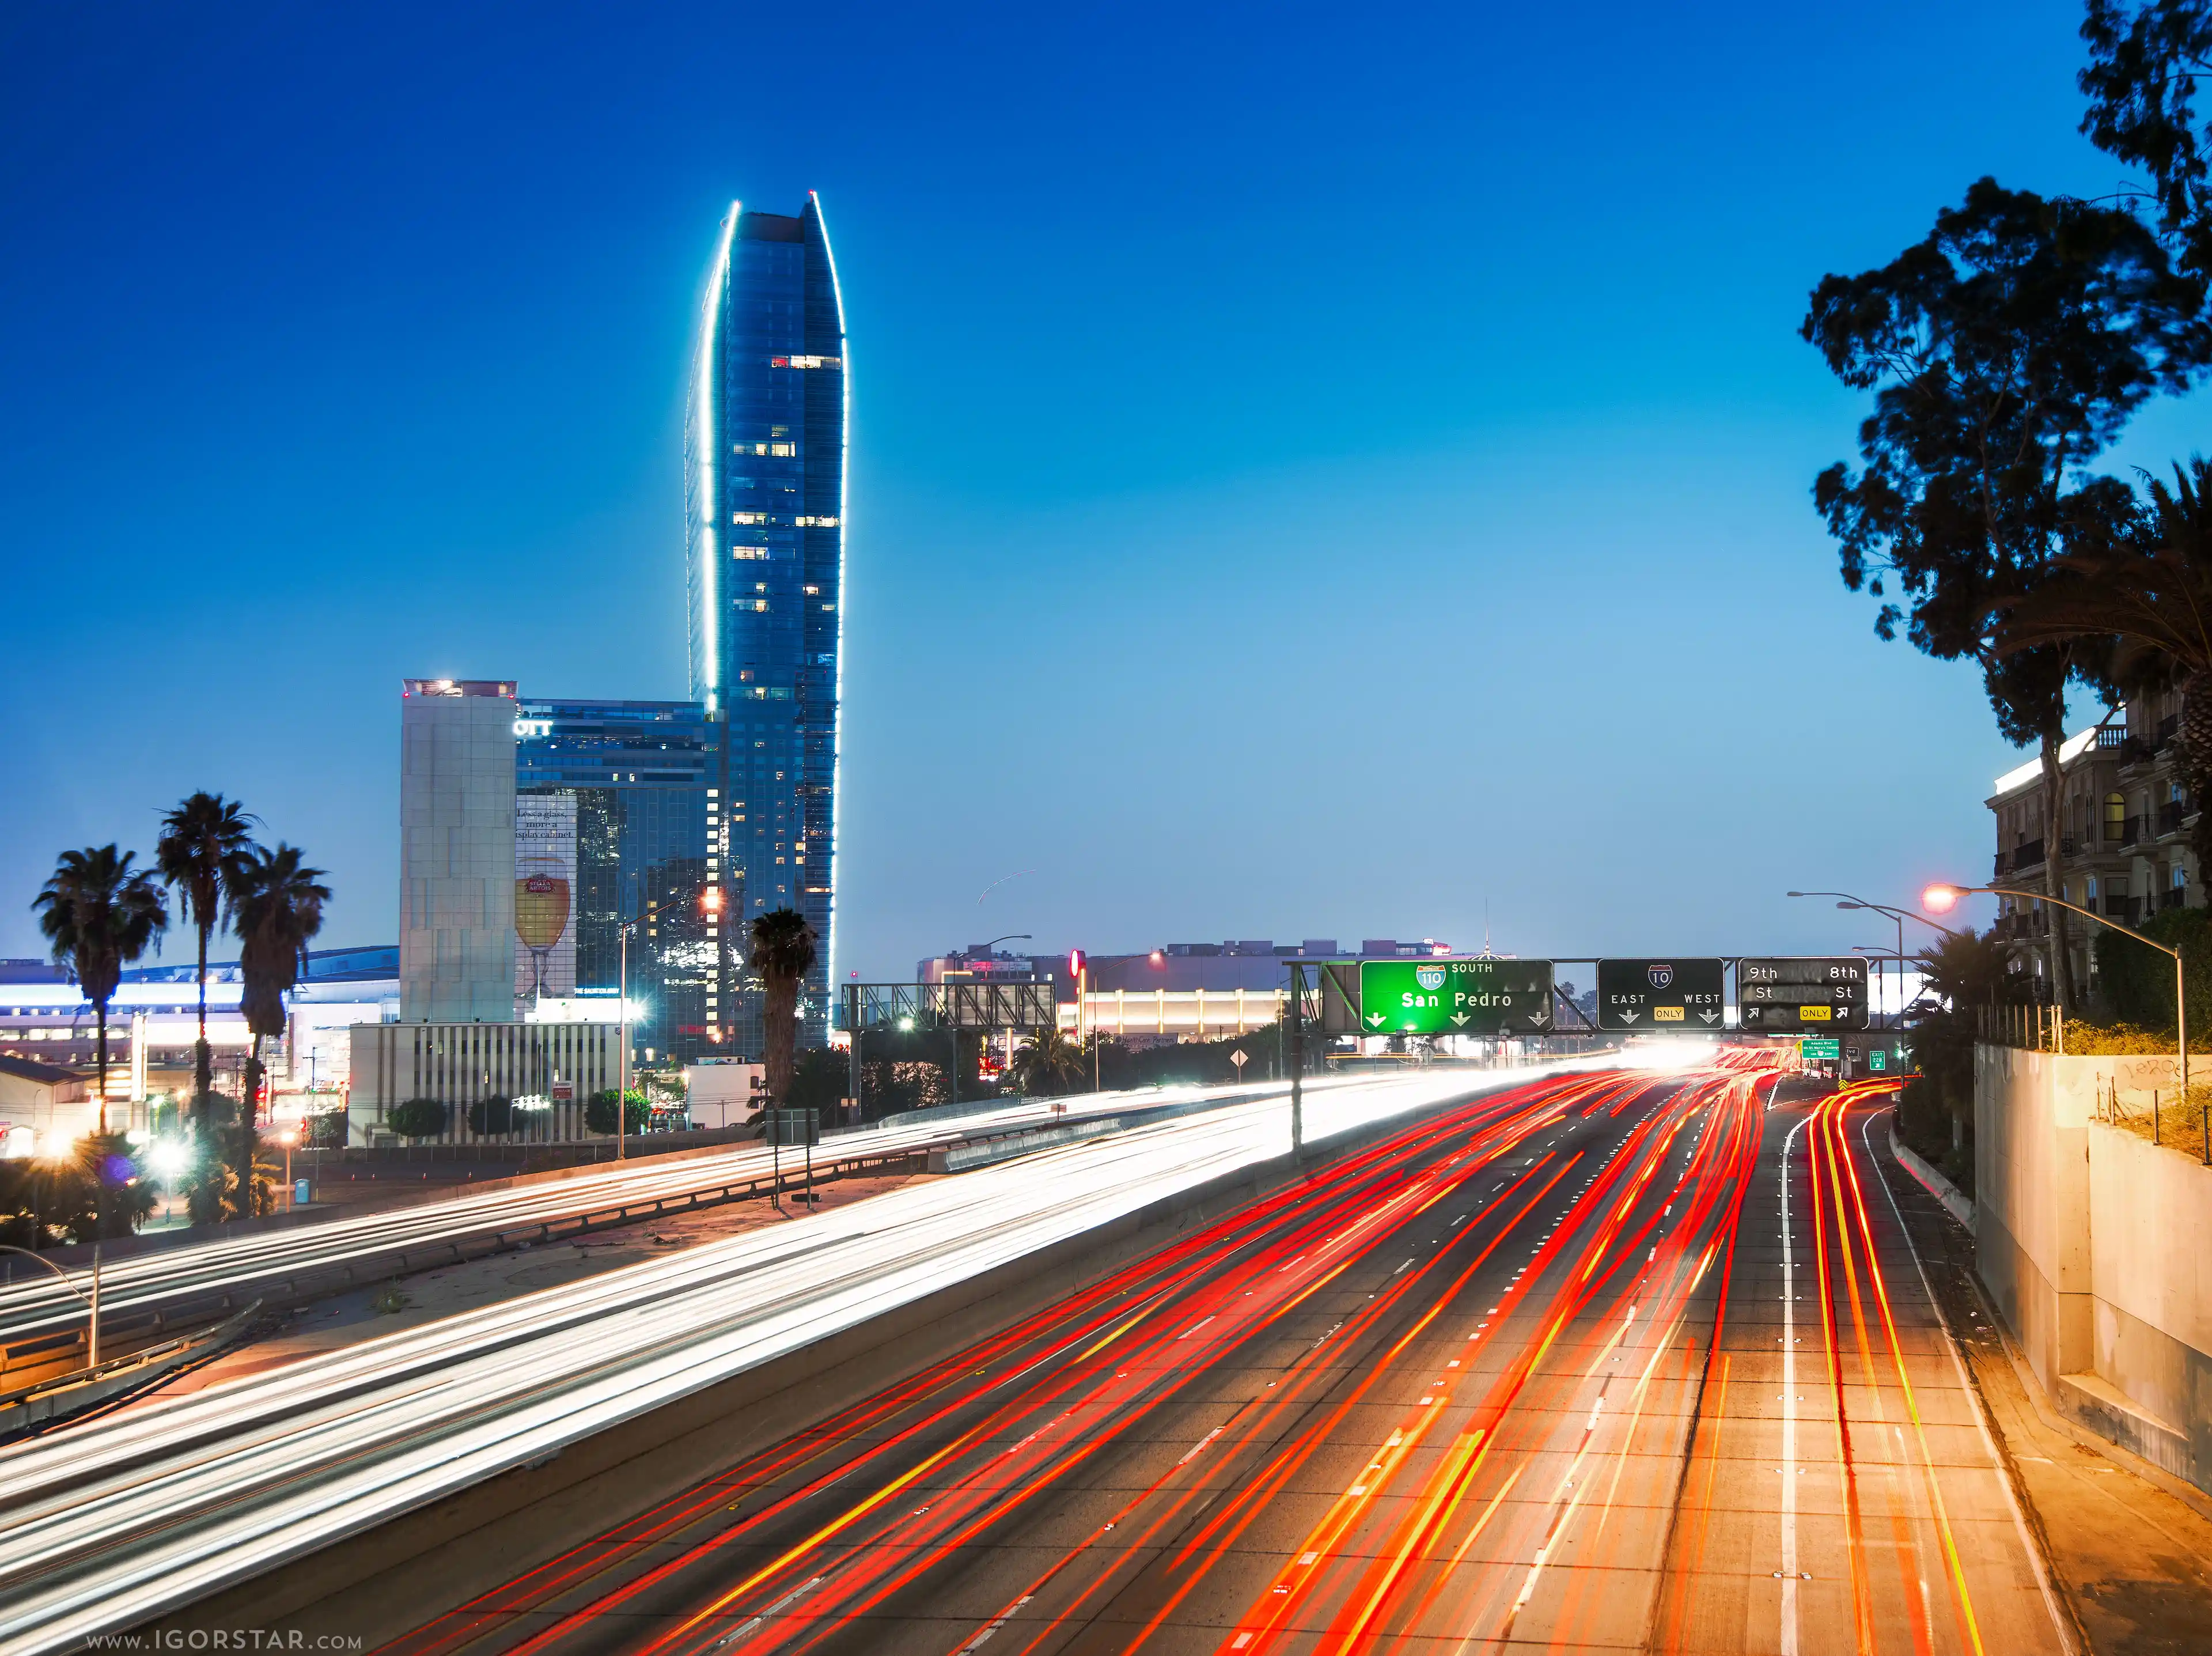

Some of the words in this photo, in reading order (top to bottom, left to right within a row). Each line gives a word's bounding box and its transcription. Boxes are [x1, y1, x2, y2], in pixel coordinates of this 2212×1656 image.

[544, 810, 567, 820] glass,
[516, 830, 539, 841] isplay
[541, 830, 574, 838] cabinet.
[1422, 973, 1441, 984] 110
[1452, 963, 1492, 973] SOUTH
[1653, 972, 1669, 983] 10
[1749, 967, 1778, 980] 9th
[1830, 967, 1858, 979] 8th
[1756, 986, 1772, 999] St
[1835, 986, 1853, 999] St
[1402, 992, 1438, 1007] San
[1455, 992, 1512, 1007] Pedro
[1612, 995, 1645, 1004] EAST
[1684, 994, 1720, 1004] WEST
[1656, 1009, 1681, 1019] ONLY
[1802, 1008, 1828, 1019] ONLY
